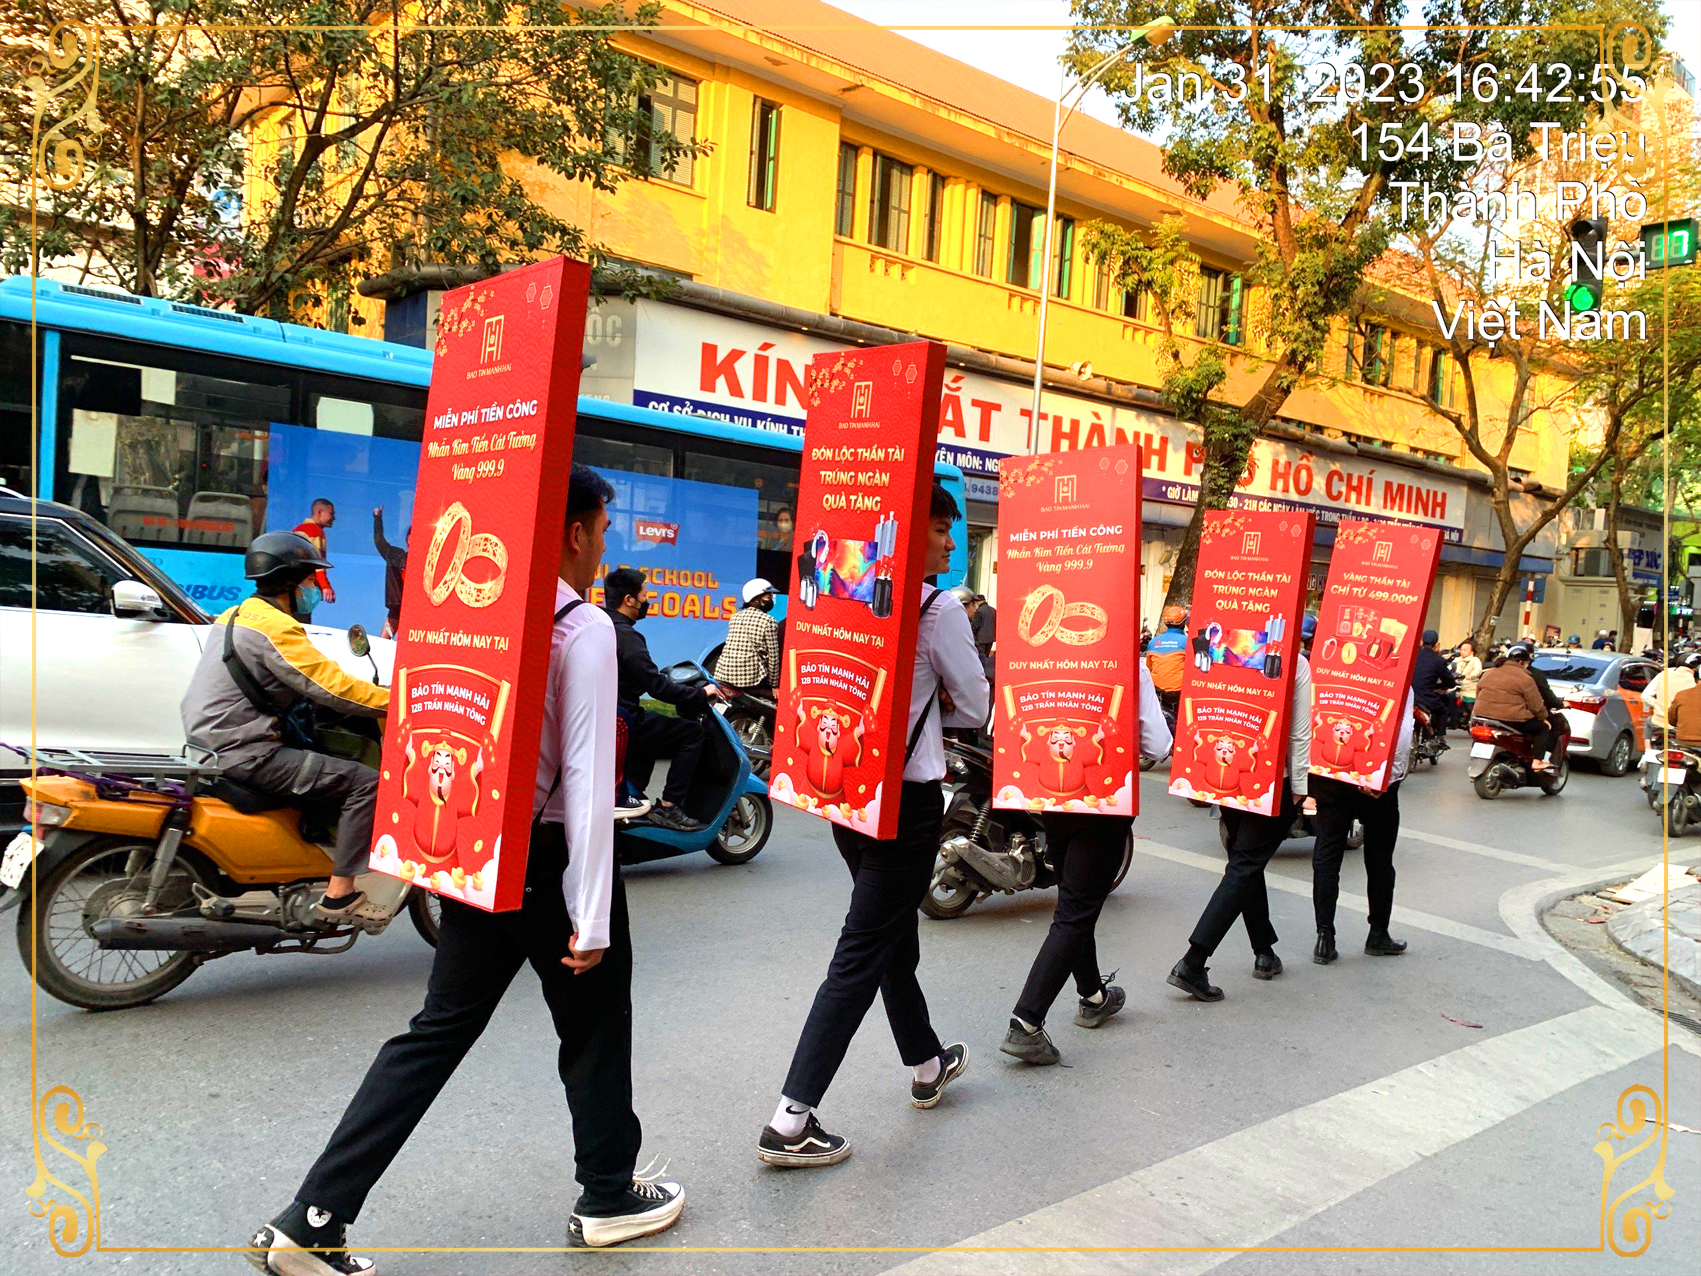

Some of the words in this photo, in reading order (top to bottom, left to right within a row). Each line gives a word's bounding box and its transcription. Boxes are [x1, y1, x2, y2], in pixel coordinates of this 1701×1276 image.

[433, 408, 459, 429] MIỄN
[461, 406, 478, 425] PHÍ
[480, 401, 504, 423] TIỀN
[506, 399, 538, 418] CÔNG
[700, 341, 813, 411] KÍN
[938, 375, 1003, 443] ẮT
[1019, 407, 1169, 472] THÀNH
[1270, 450, 1315, 497] HỒ
[1325, 469, 1376, 507] CHÍ
[1383, 480, 1448, 520] MINH
[428, 438, 450, 458] Nhẫn
[452, 439, 469, 455] Kim
[471, 433, 489, 452] Tiền
[491, 433, 505, 450] Cát
[507, 431, 537, 449] Tường
[811, 445, 832, 461] ĐÓN
[835, 446, 855, 464] LỘC
[857, 444, 885, 461] THẦN
[888, 445, 905, 462] TÀI
[452, 463, 475, 484] Vàng
[476, 459, 504, 478] 999.9
[820, 468, 855, 485] TRÚNG
[857, 469, 890, 486] NGÀN
[822, 491, 846, 511] QUÀ
[849, 492, 881, 513] TẶNG
[1010, 529, 1037, 542] MIỄN
[1040, 528, 1059, 540] PHÍ
[1061, 526, 1086, 538] TIỀN
[1090, 524, 1123, 536] CÔNG
[1006, 547, 1031, 560] Nhẫn
[1034, 547, 1052, 558] Kim
[1054, 544, 1074, 556] Tiền
[1076, 544, 1092, 555] Cát
[1094, 542, 1125, 554] Tường
[1036, 562, 1062, 574] Vàng
[1064, 559, 1093, 571] 999.9
[1204, 569, 1225, 580] ĐÓN
[1227, 570, 1245, 582] LỘC
[1247, 571, 1274, 582] THẦN
[1276, 573, 1291, 583] TÀI
[1213, 584, 1246, 596] TRÚNG
[1248, 586, 1278, 598] NGÀN
[1216, 599, 1238, 610] QUÀ
[1241, 600, 1270, 614] TẶNG
[408, 629, 426, 643] DUY
[426, 626, 450, 646] NHẤT
[450, 629, 472, 648] HÔM
[473, 636, 492, 649] NAY
[492, 636, 509, 654] TẠI
[796, 621, 812, 632] DUY
[812, 623, 832, 636] NHẤT
[833, 627, 852, 641] HÔM
[852, 633, 870, 644] NAY
[871, 635, 884, 649] TẠI
[1010, 662, 1028, 670] DUY
[1030, 659, 1054, 669] NHẤT
[1056, 659, 1078, 669] HÔM
[1102, 660, 1118, 670] TẠI
[801, 662, 816, 673] BẢO
[818, 662, 830, 672] TÍN
[831, 666, 854, 680] MẠNH
[855, 674, 870, 689] HẢI
[411, 682, 430, 698] BẢO
[430, 682, 445, 695] TÍN
[446, 685, 472, 703] MẠNH
[474, 690, 490, 710] HẢI
[812, 675, 829, 684] TRẦN
[829, 678, 848, 690] NHÂN
[849, 684, 866, 700] TÔNG
[1020, 692, 1039, 703] BẢO
[1041, 690, 1055, 699] TÍN
[1058, 692, 1086, 700] MẠNH
[1088, 692, 1104, 704] HẢI
[411, 701, 423, 713] 12B
[424, 698, 442, 712] TRẦN
[443, 700, 465, 716] NHÂN
[466, 706, 486, 726] TÔNG
[1035, 700, 1055, 708] TRẦN
[1080, 701, 1102, 713] TÔNG
